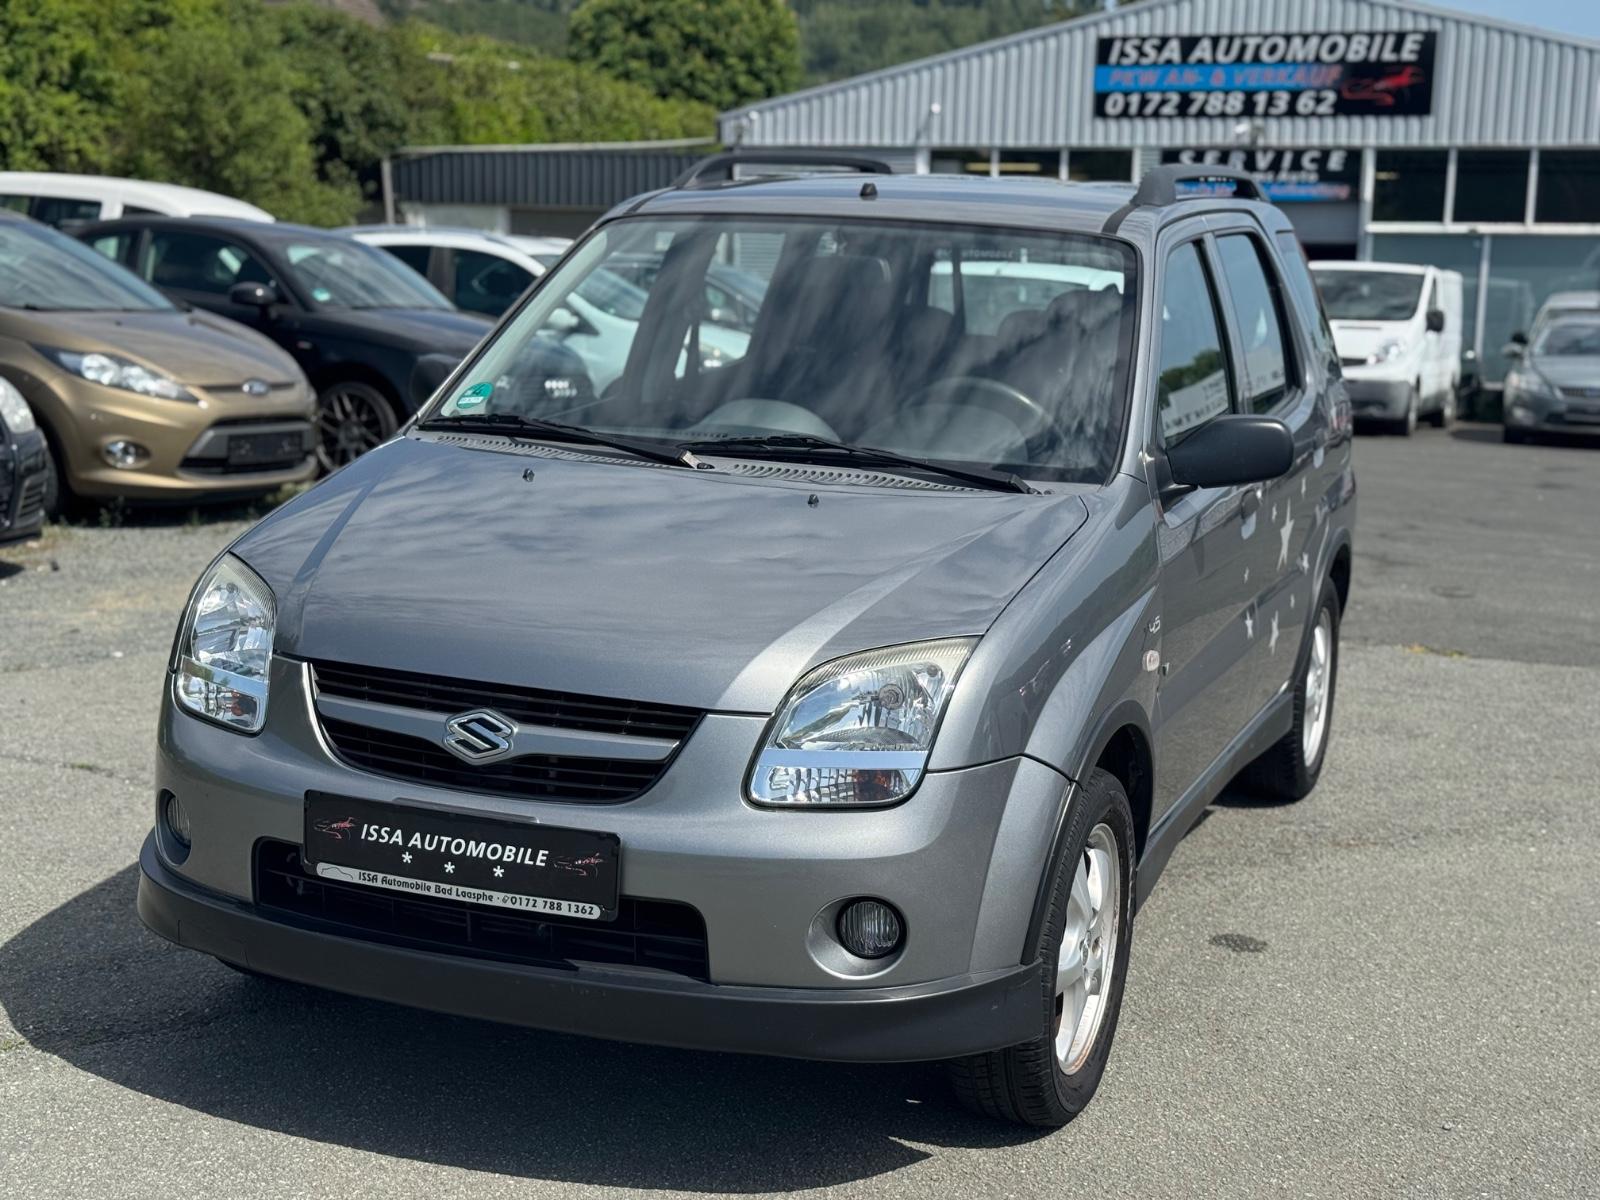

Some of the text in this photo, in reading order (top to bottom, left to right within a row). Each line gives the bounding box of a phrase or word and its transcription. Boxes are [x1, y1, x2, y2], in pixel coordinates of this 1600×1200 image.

[1108, 33, 1425, 66] ISSA AUTOMOBILE
[1108, 69, 1162, 86] PKW
[1233, 65, 1344, 85] VERKAUF
[1104, 89, 1338, 116] 0172 788 13 62
[1178, 149, 1348, 172] SERVICE
[360, 823, 549, 867] ISSA AUTOMOBILE
[358, 872, 594, 915] ISSA Automobile Bad Laasphe 0172 788 1362
